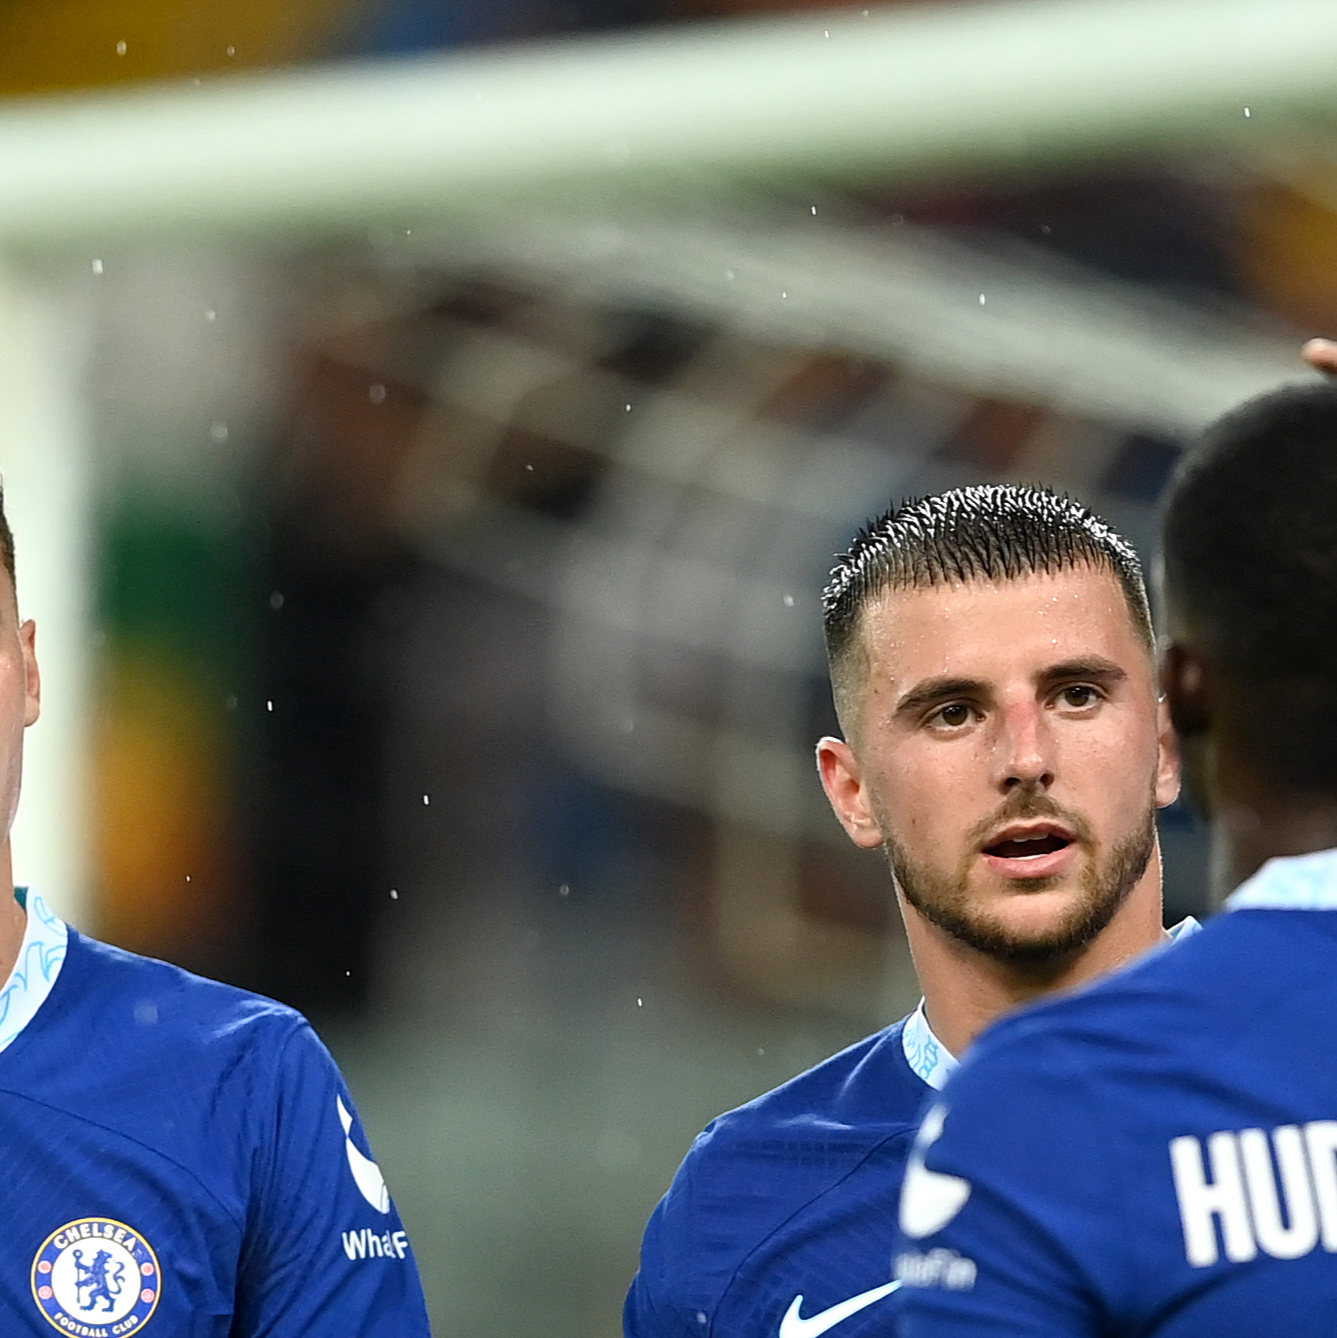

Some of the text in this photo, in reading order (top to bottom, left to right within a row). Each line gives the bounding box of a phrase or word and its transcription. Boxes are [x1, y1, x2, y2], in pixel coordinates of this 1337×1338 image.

[53, 1223, 139, 1254] CHELSEA
[53, 1312, 140, 1338] FOOTBALL CLUB
